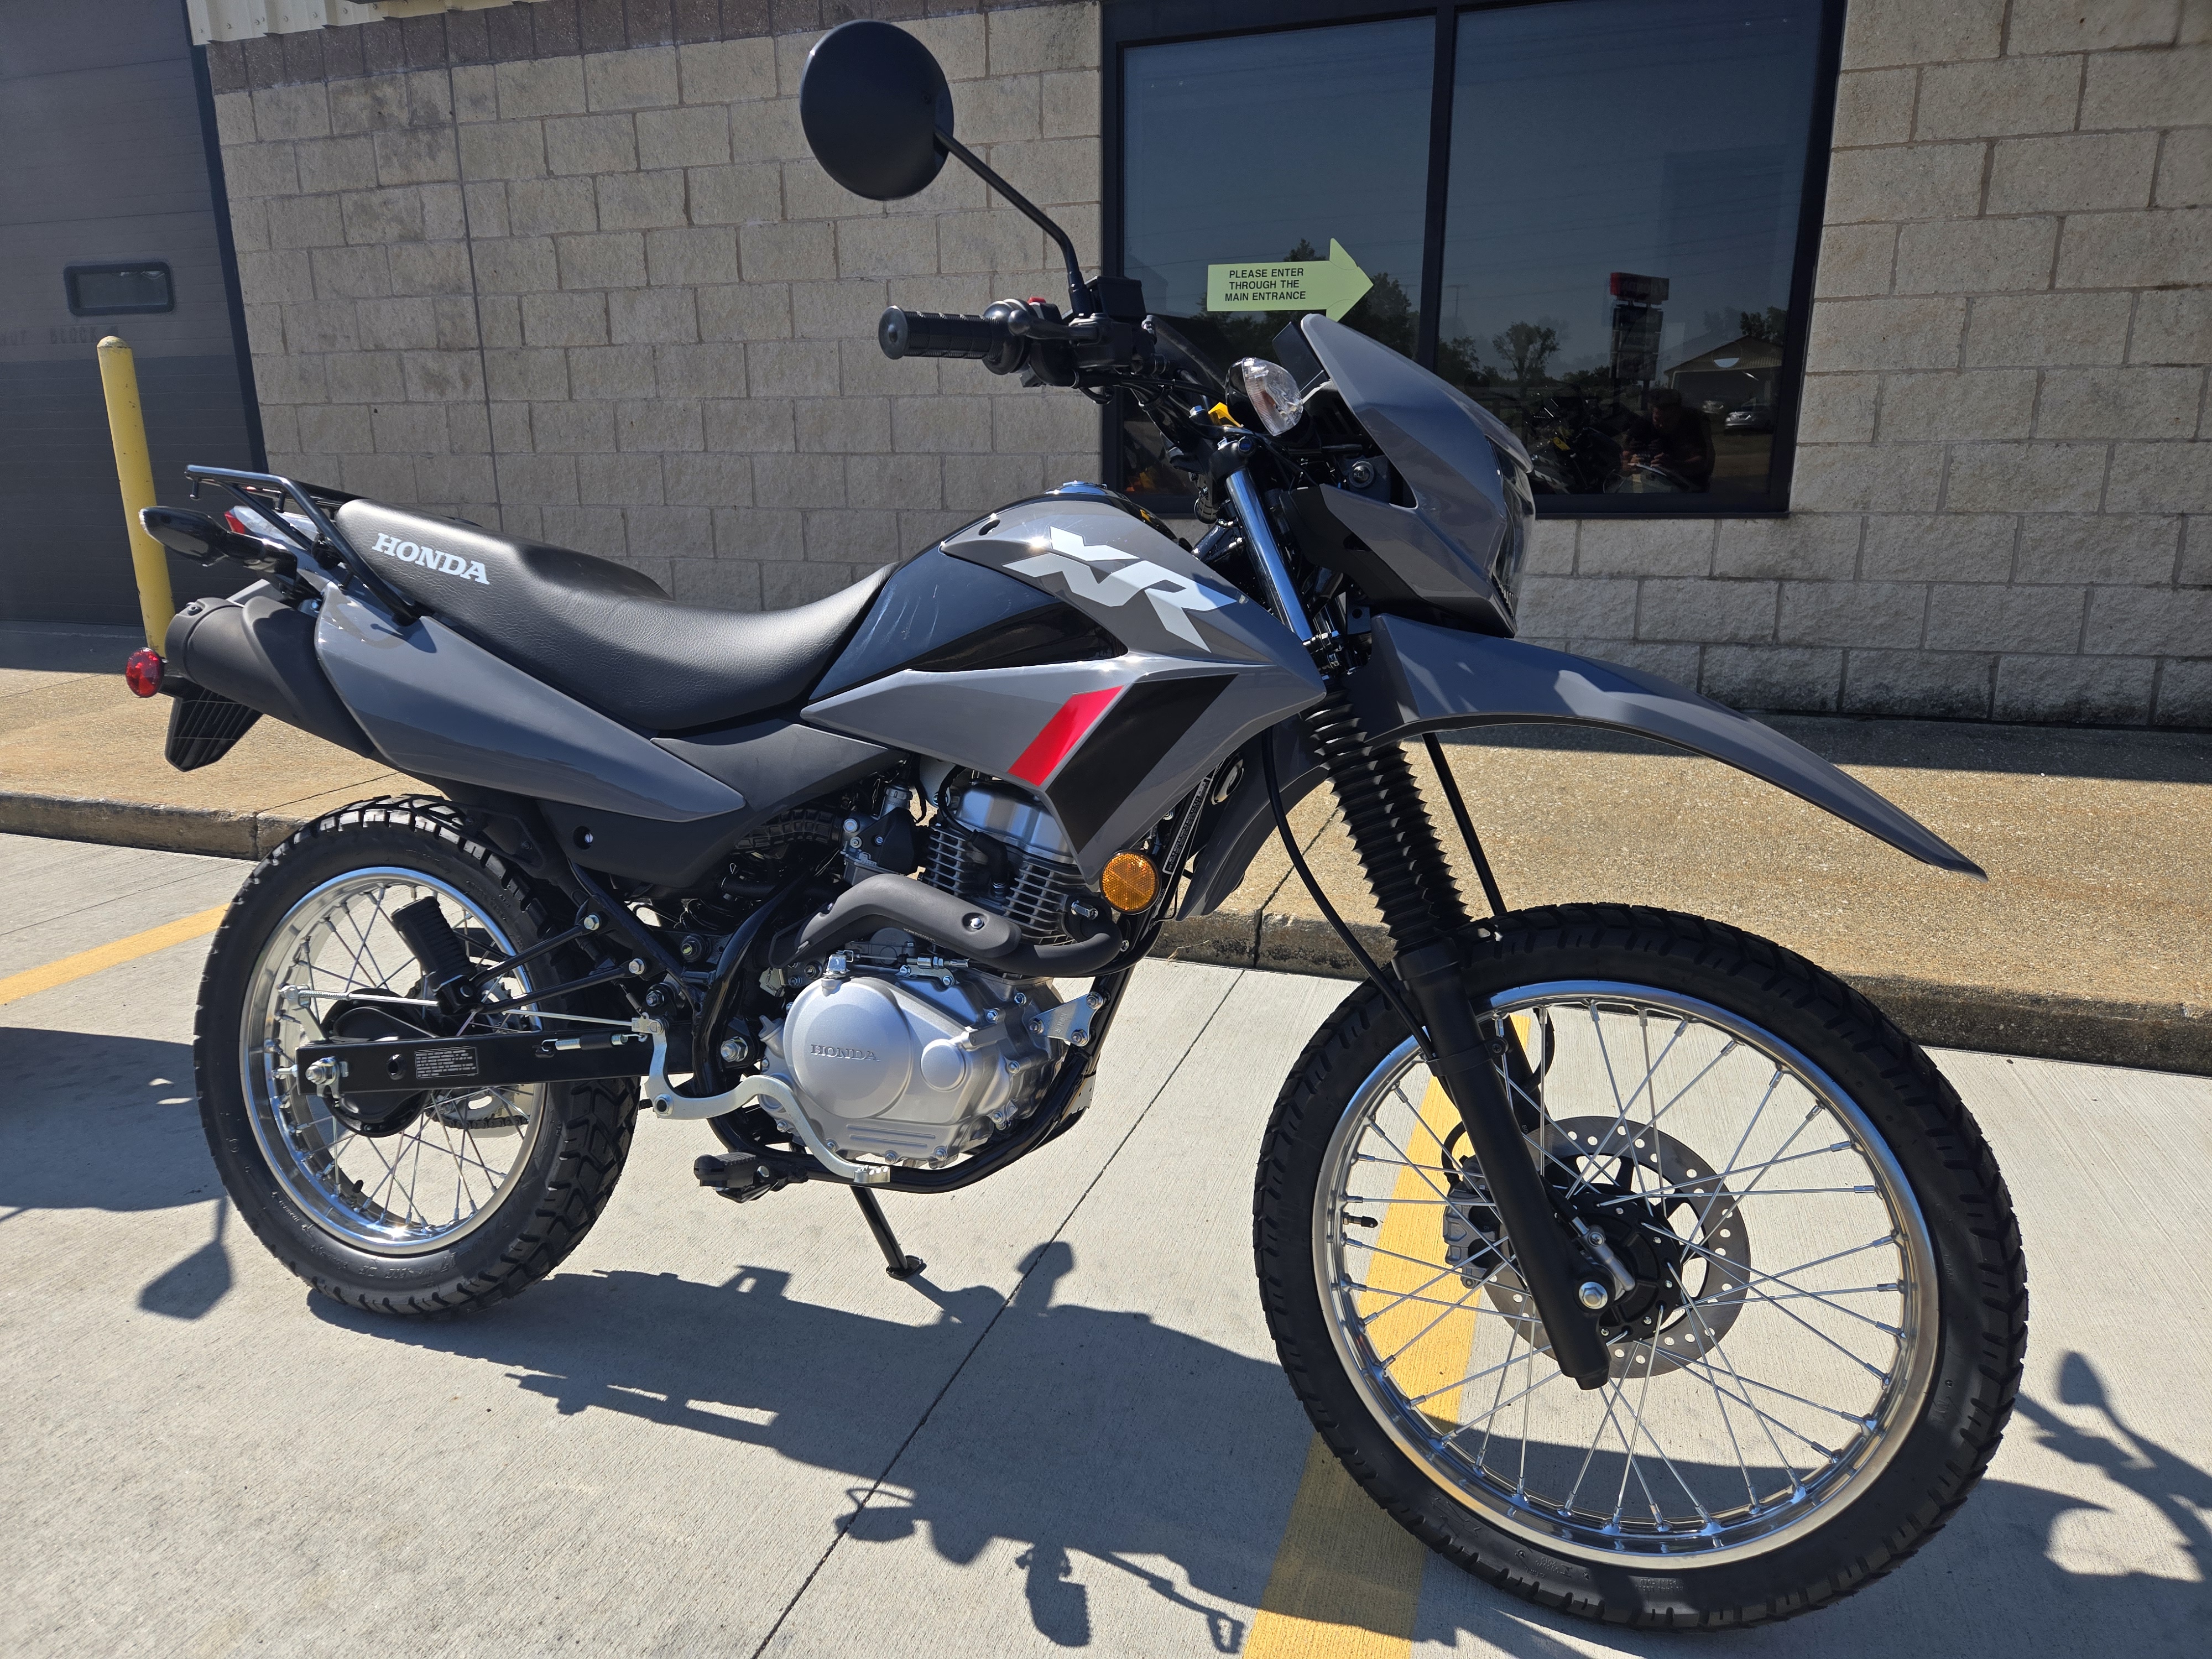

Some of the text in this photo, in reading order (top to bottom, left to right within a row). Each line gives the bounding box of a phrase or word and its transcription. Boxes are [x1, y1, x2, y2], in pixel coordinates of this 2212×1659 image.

[1229, 268, 1304, 278] PLEASE ENTER
[1229, 280, 1300, 290] THROUGH THE
[1225, 291, 1306, 301] MAIN ENTRANCE
[372, 533, 490, 585] HONDA
[1002, 526, 1237, 653] XR
[811, 1044, 881, 1062] HONDA
